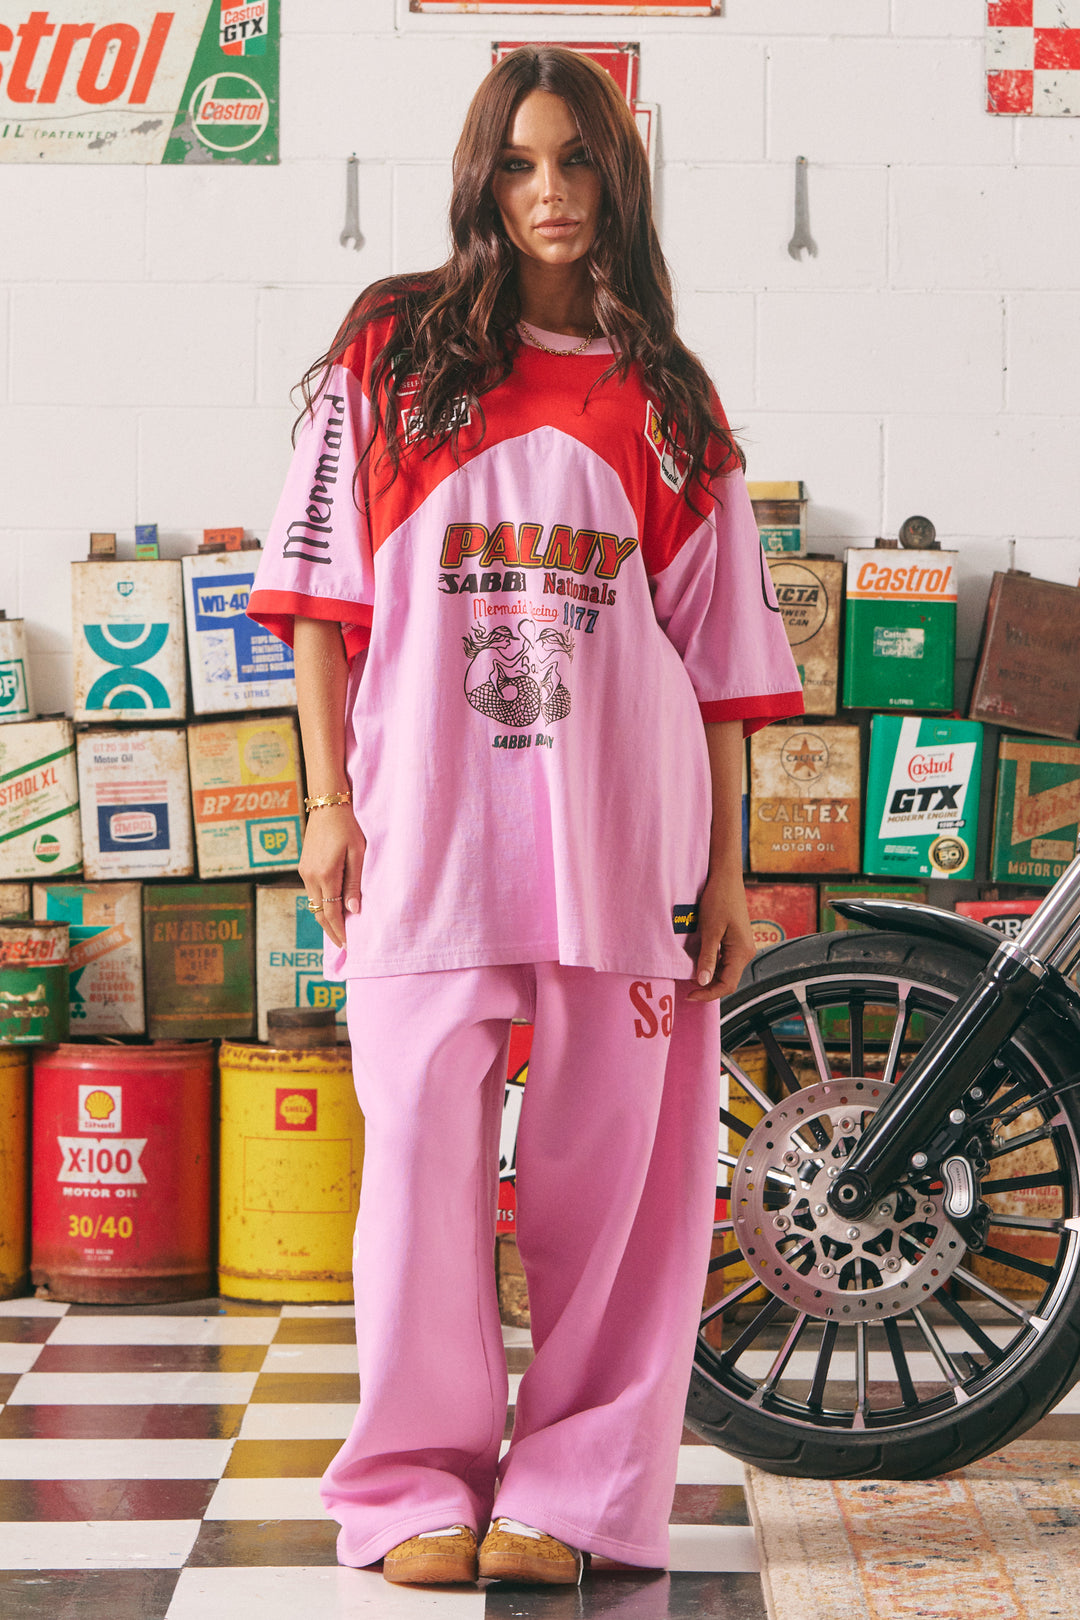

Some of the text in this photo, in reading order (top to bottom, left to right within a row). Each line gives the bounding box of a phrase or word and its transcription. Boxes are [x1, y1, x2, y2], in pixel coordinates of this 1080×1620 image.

[224, 2, 265, 25] Castrol
[223, 16, 263, 43] GTX
[0, 12, 175, 104] trol
[201, 101, 264, 120] Castrol
[283, 394, 345, 565] Mermaid
[440, 522, 638, 580] PALMY
[856, 562, 952, 593] Castrol
[543, 573, 617, 605] Nationals
[201, 593, 249, 613] WD-40
[492, 735, 532, 749] SABBI
[41, 767, 58, 789] XL
[908, 752, 955, 783] Castrol
[201, 789, 292, 815] BP ZOOM
[889, 784, 963, 814] GTX
[758, 804, 850, 822] CALTEX
[887, 811, 958, 823] MODERN ENGINE
[114, 821, 153, 834] AMPOL
[783, 826, 820, 840] RPM
[264, 833, 286, 849] BP
[771, 843, 835, 852] MOTOR OIL
[1008, 861, 1050, 877] MOTOR
[153, 920, 243, 942] ENERGOL
[313, 986, 346, 1008] BP
[68, 1148, 132, 1174] X-100
[63, 1187, 139, 1198] MOTOR OIL
[68, 1214, 133, 1239] 30/40
